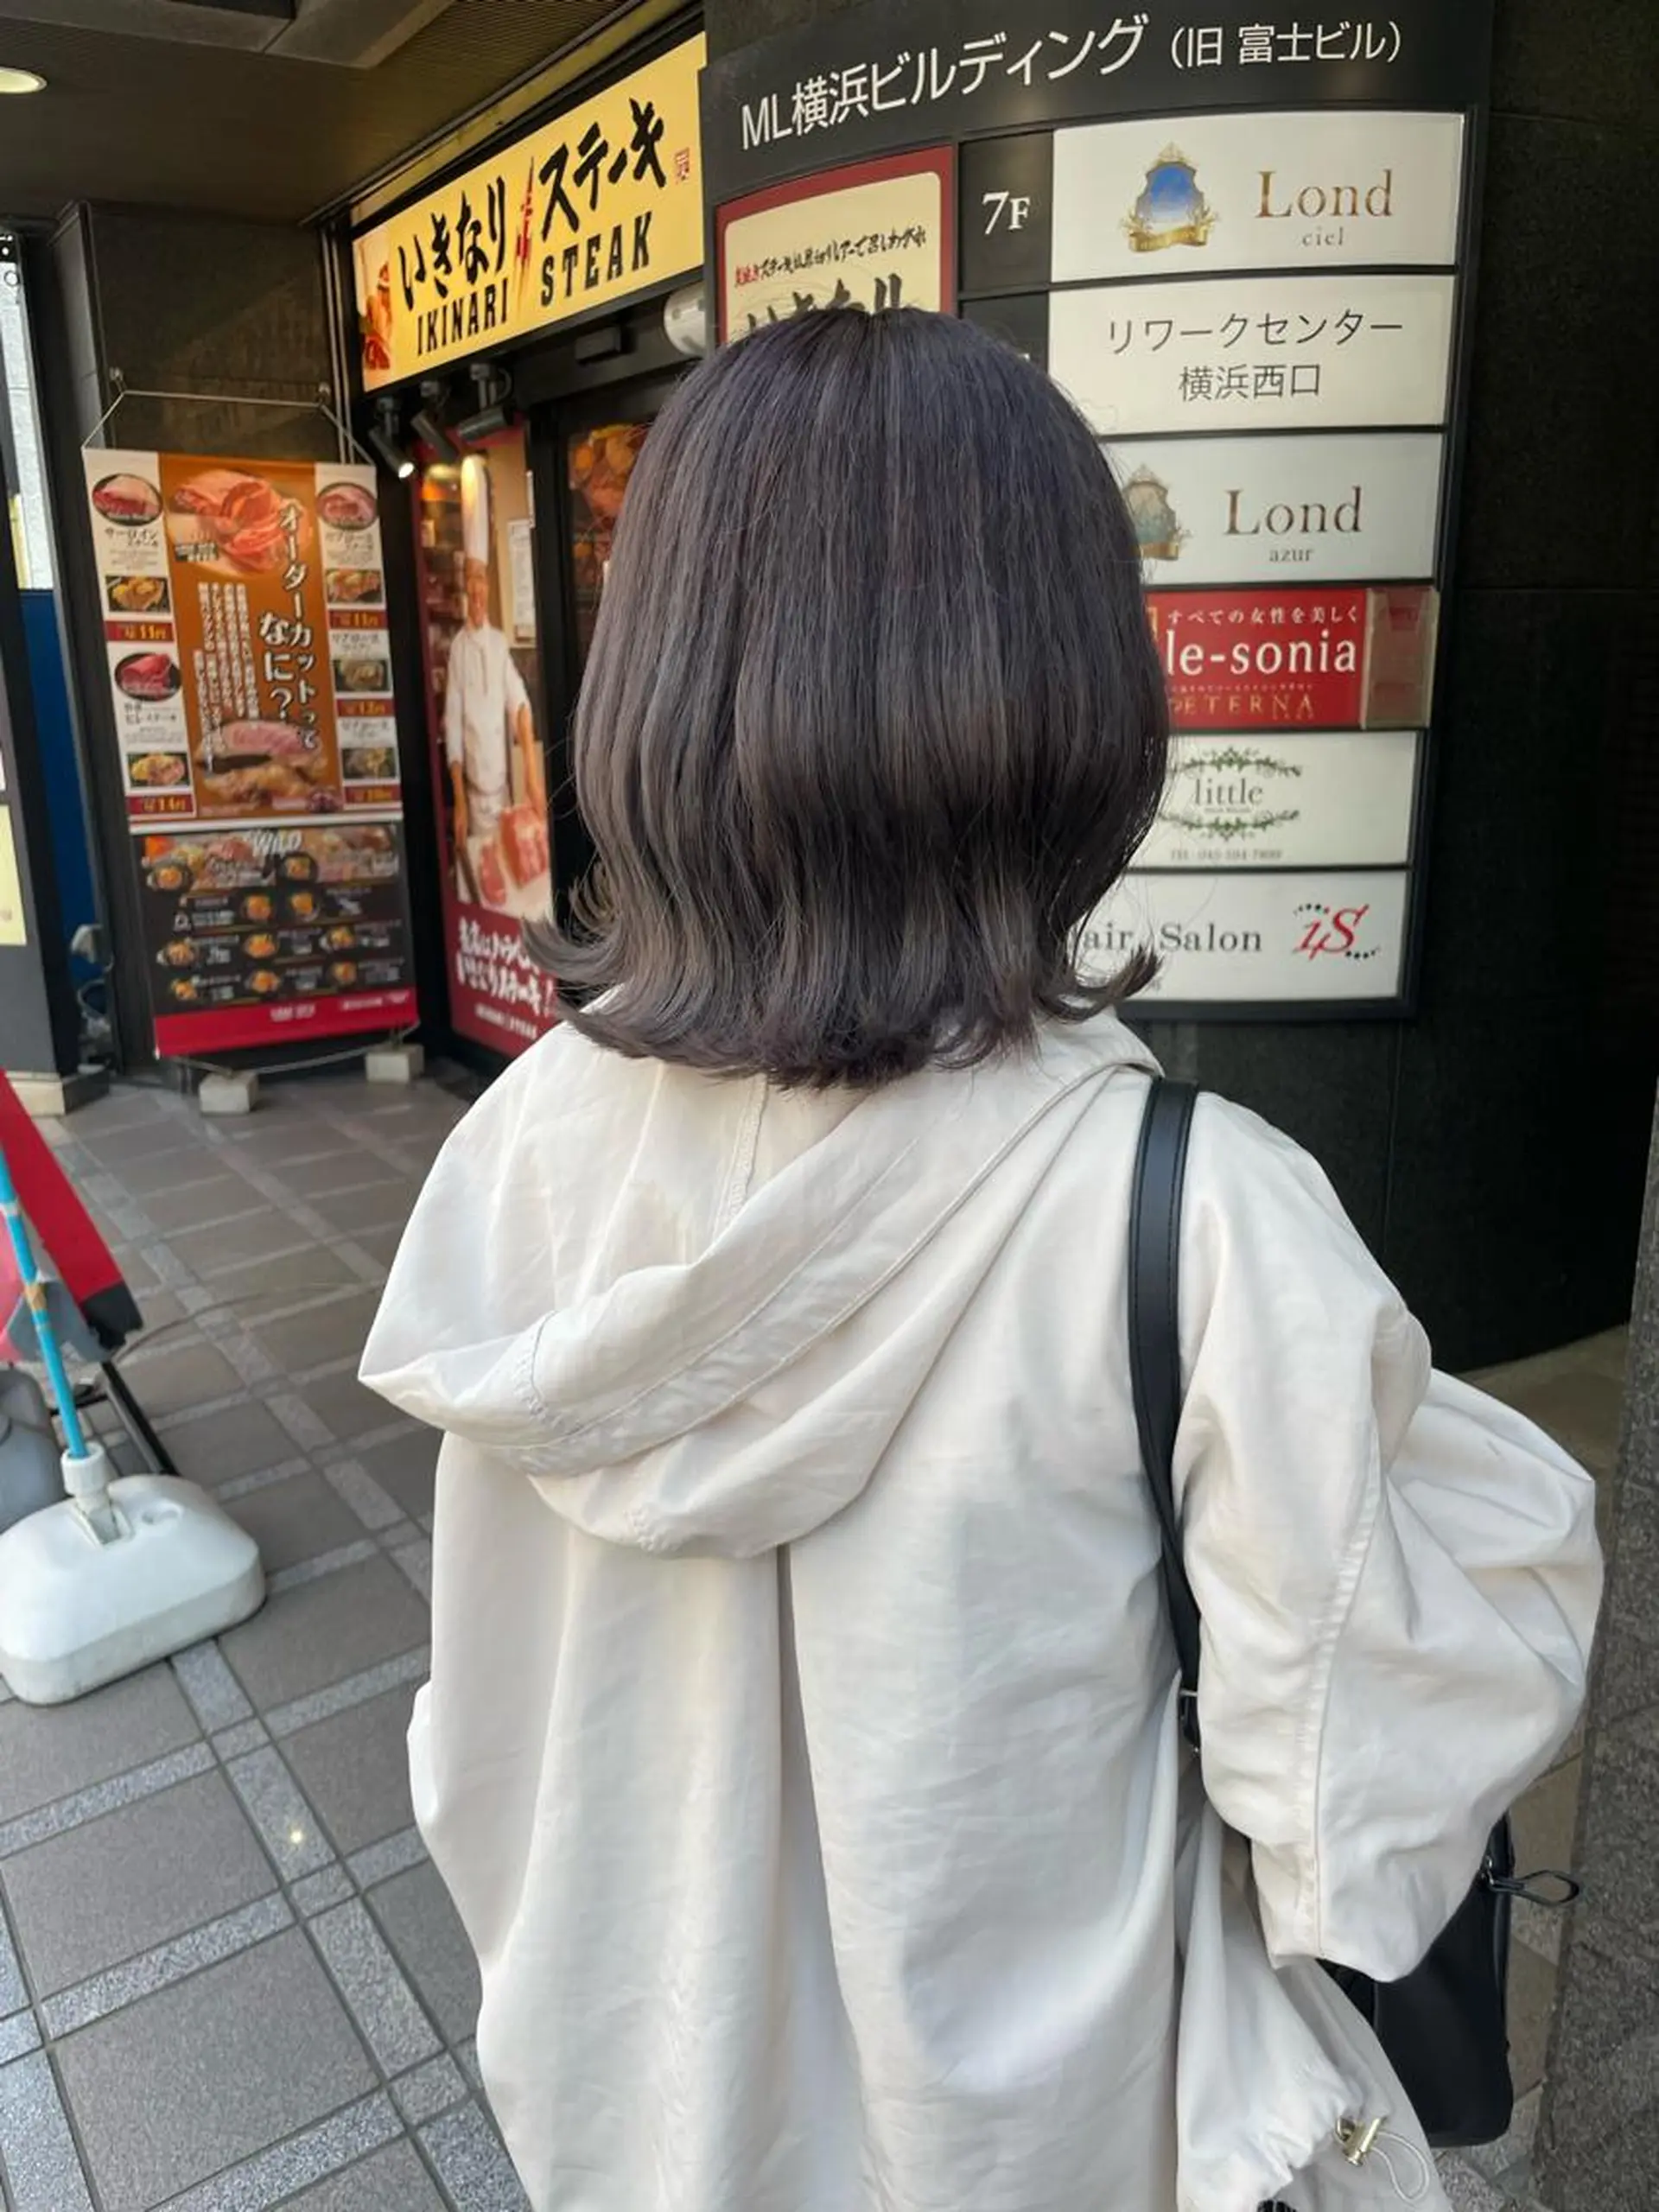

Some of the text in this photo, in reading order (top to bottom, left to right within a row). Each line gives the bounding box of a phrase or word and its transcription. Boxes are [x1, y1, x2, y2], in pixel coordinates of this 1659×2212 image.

[741, 12, 1151, 150] ML横浜ビルディング
[397, 97, 668, 311] いきなり ステーキ
[981, 190, 1031, 235] 7F
[1255, 168, 1395, 219] Lond
[1301, 226, 1345, 247] ciel
[416, 277, 510, 357] IKINARI
[540, 210, 653, 307] STEAK
[1109, 308, 1404, 355] リワークセンター
[1178, 364, 1321, 403] 横浜西口
[1223, 485, 1364, 536] Lond
[1268, 546, 1316, 563] azur
[1167, 606, 1357, 626] すべての女性を美しく
[1166, 627, 1357, 677] le-sonia
[1194, 777, 1264, 807] little
[1075, 922, 1135, 951] air
[1160, 921, 1263, 952] Salon
